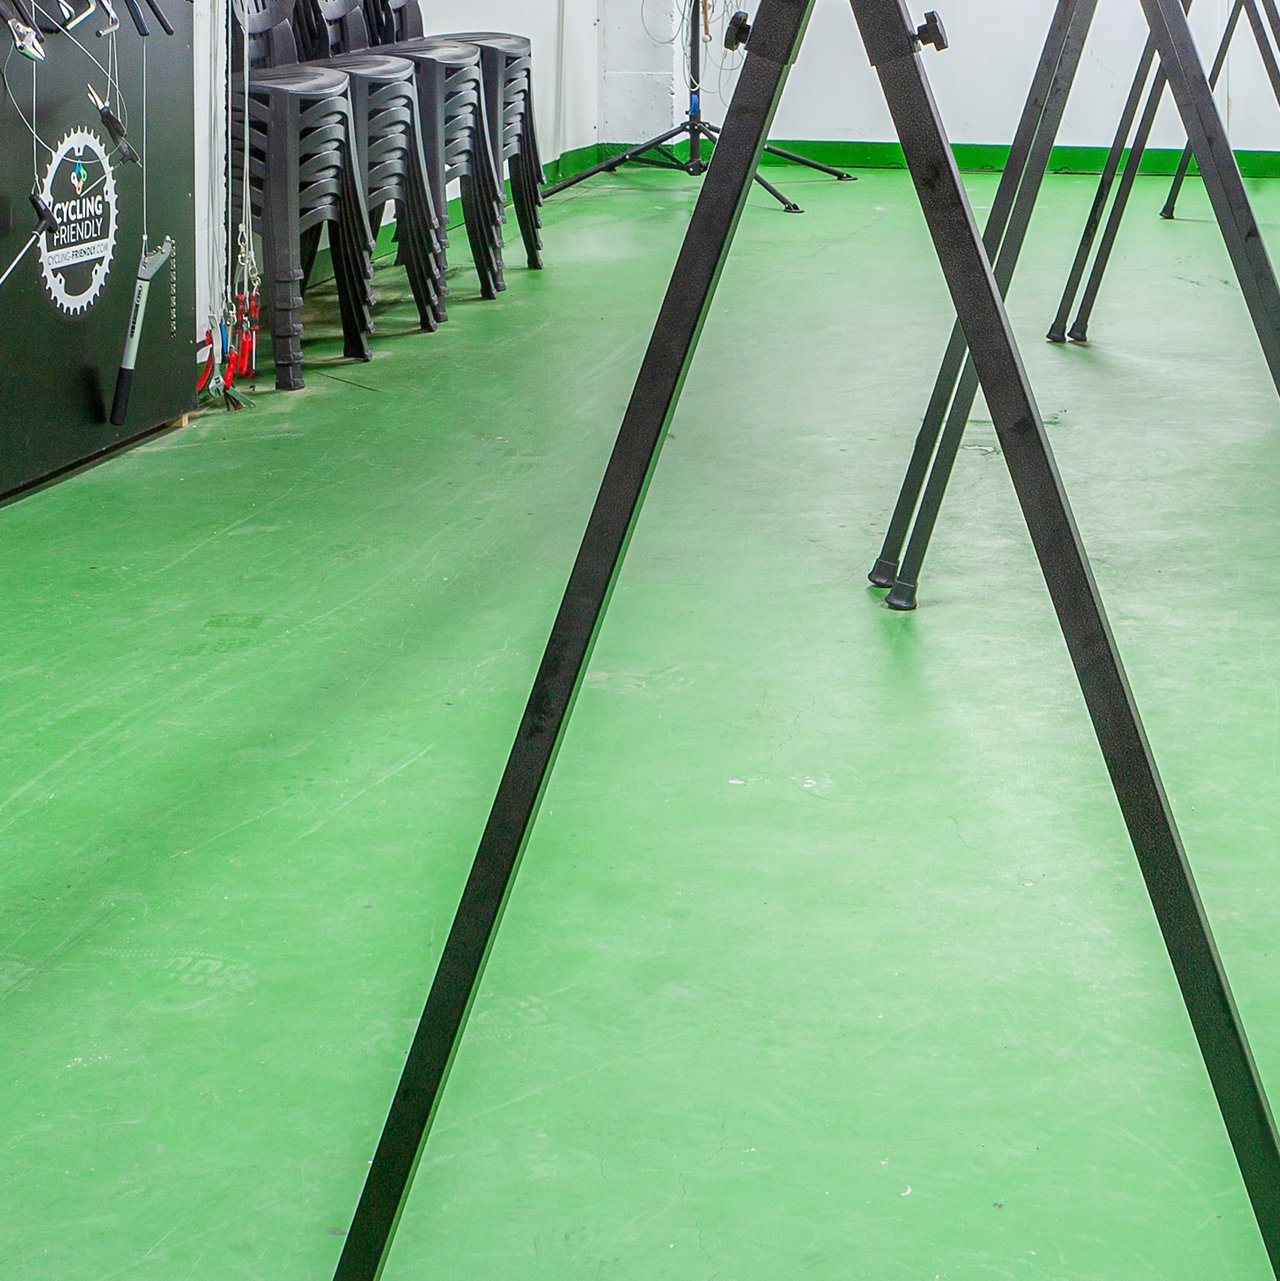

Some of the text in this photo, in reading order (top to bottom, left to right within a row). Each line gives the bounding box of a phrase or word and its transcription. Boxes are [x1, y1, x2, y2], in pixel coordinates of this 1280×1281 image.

[53, 195, 103, 224] CYCLING
[54, 218, 103, 246] FRIENDLY
[48, 243, 108, 266] CYCLING-FRIENDLY.COM
